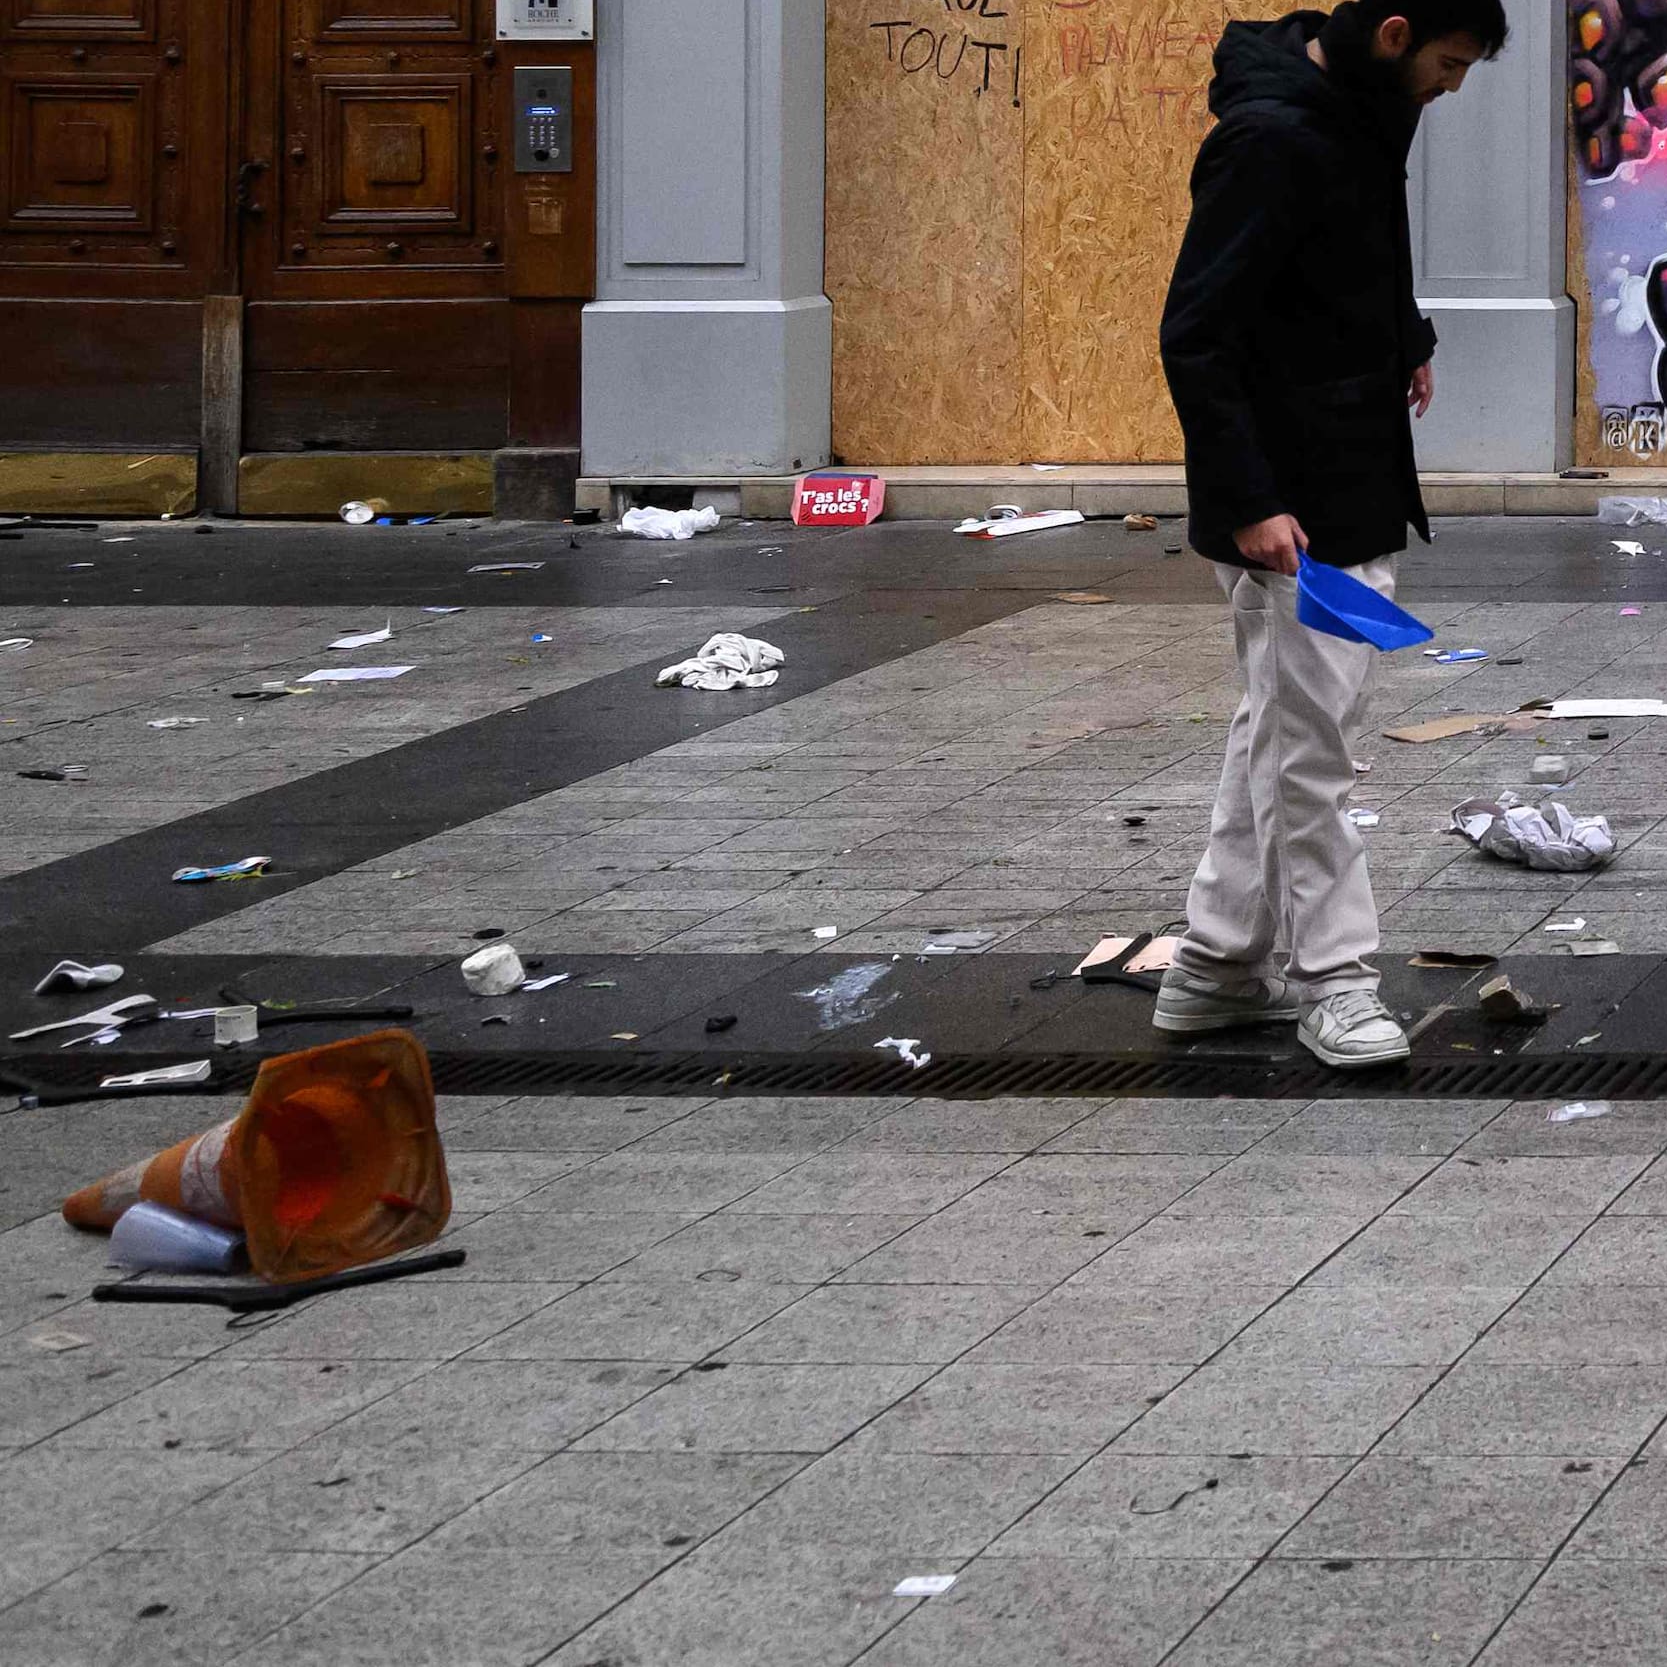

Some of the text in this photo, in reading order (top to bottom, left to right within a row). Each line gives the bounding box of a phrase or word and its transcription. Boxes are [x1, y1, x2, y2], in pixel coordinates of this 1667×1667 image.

[801, 488, 861, 504] T'as les
[811, 498, 869, 515] crocs ?
